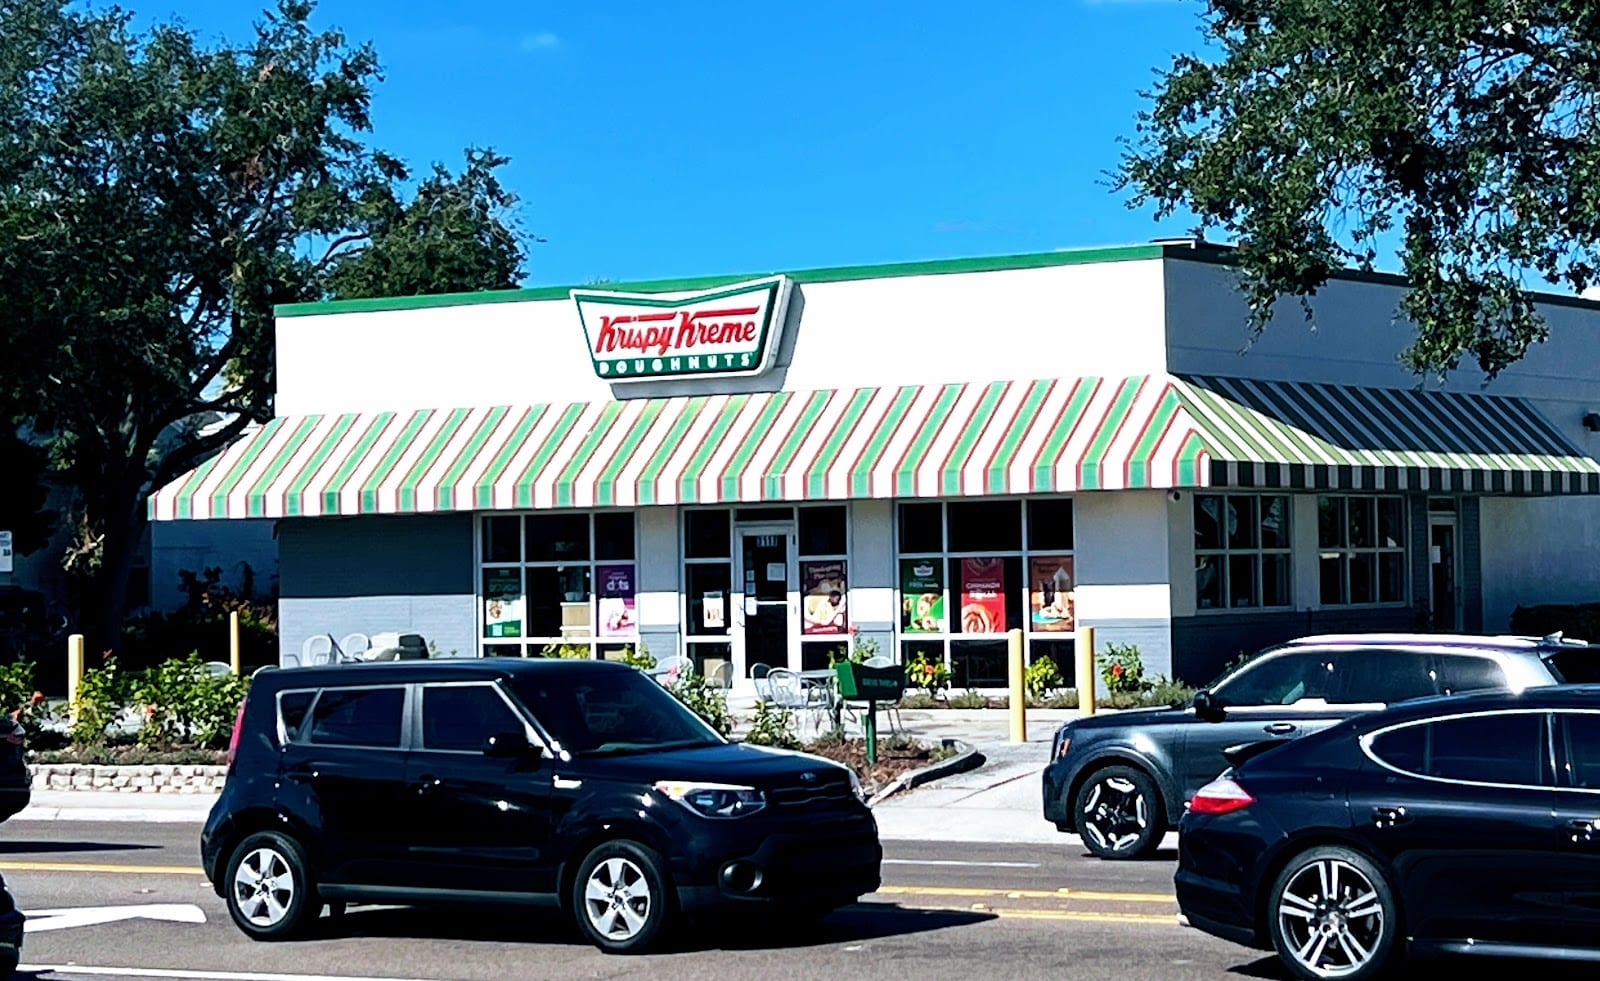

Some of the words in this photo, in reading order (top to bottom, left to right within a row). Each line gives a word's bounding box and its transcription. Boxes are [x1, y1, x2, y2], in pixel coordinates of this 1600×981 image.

[595, 311, 677, 355] Krispy
[675, 306, 760, 348] Kreme
[600, 354, 750, 374] DOUGHNUTS
